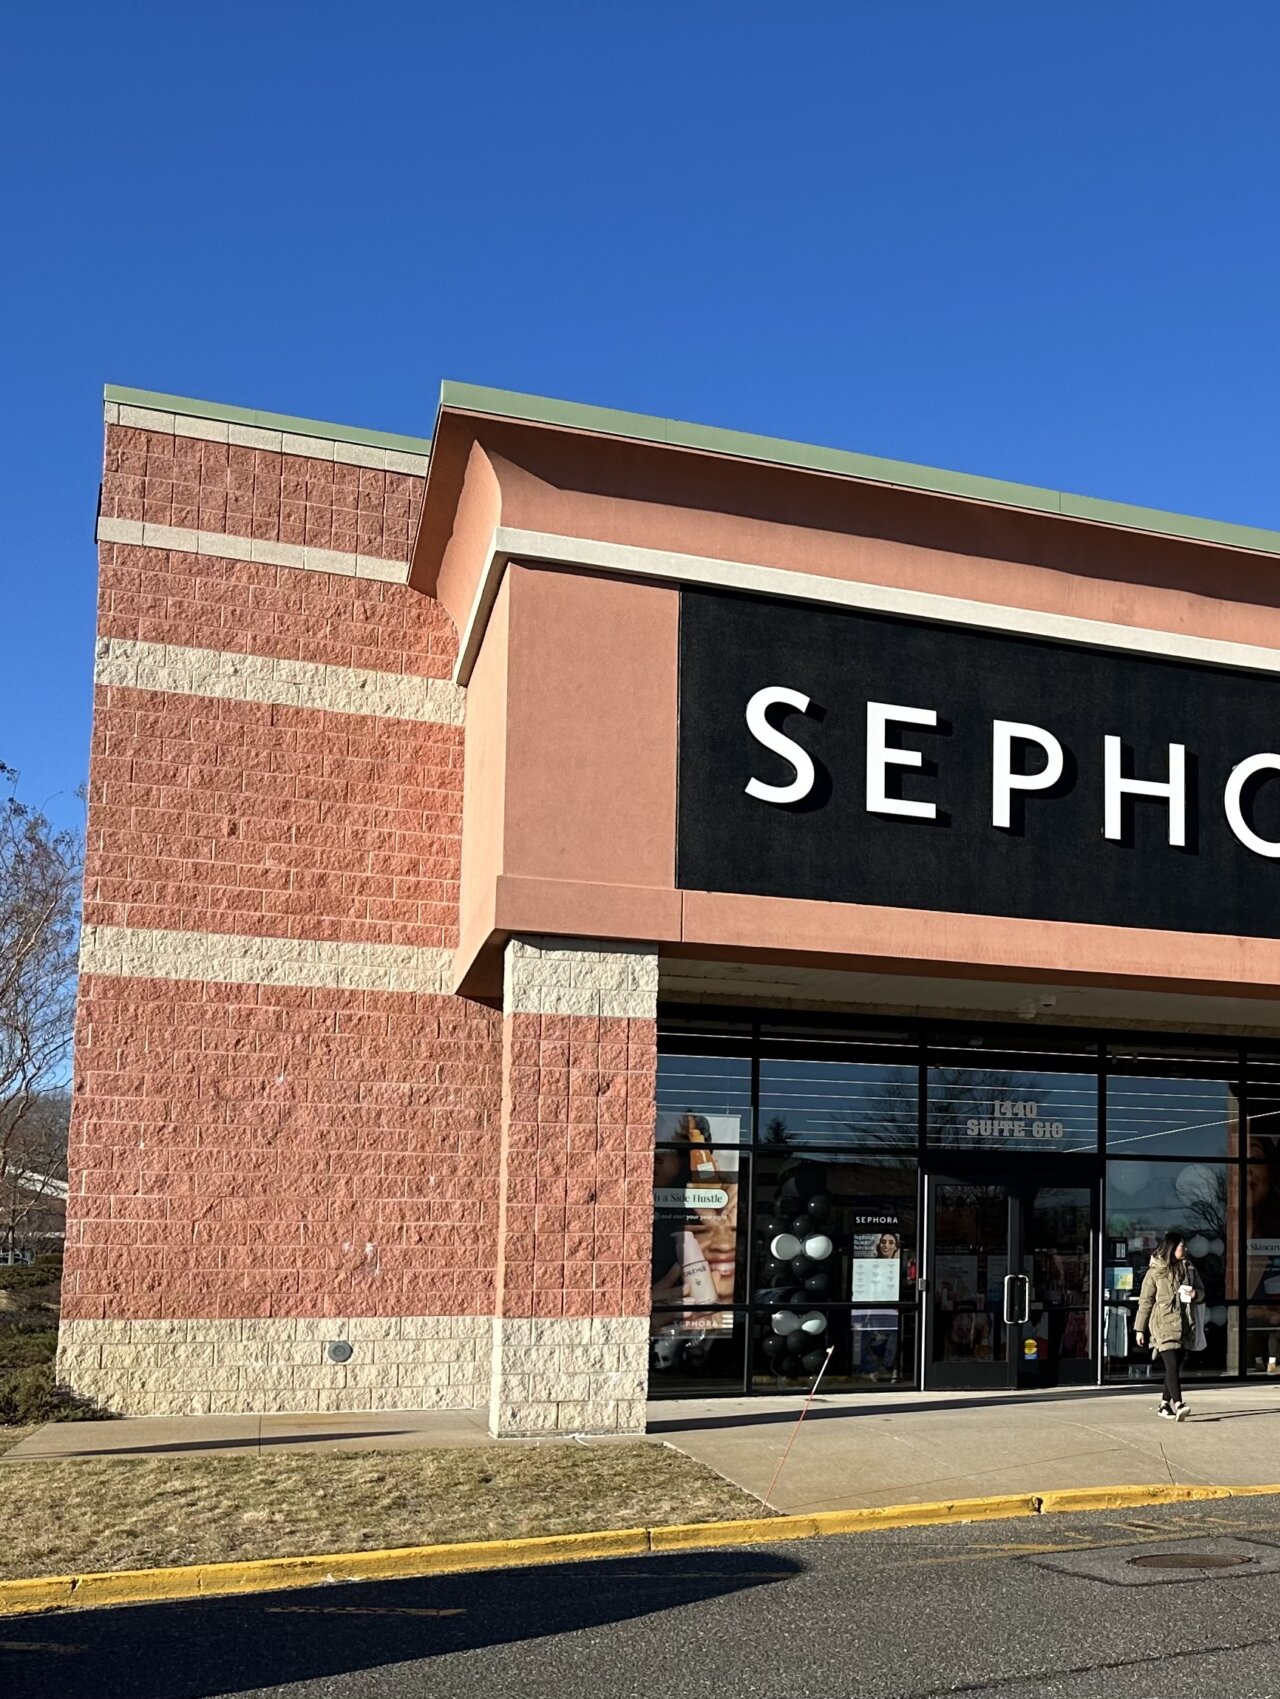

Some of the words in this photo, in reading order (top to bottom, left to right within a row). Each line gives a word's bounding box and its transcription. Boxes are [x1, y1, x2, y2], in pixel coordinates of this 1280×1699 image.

[993, 1100, 1038, 1118] 1440
[966, 1119, 1025, 1137] SUITE
[1032, 1121, 1063, 1138] 610
[671, 1193, 690, 1203] Side
[692, 1193, 723, 1204] Hustle
